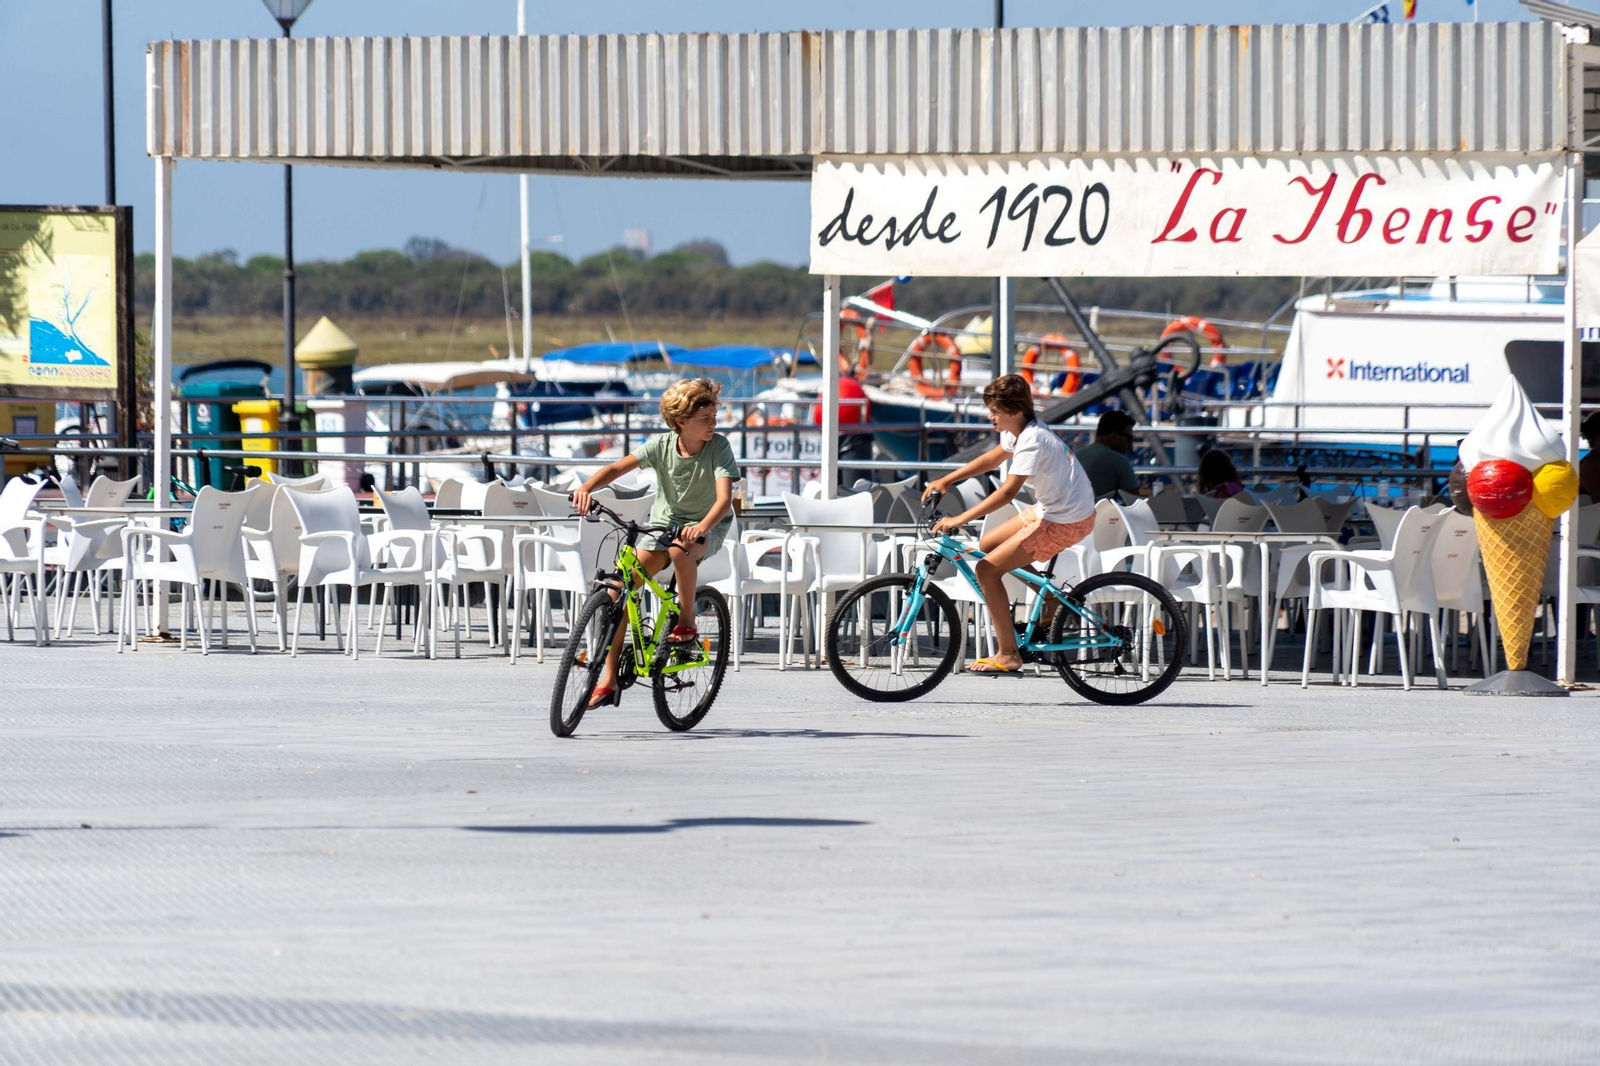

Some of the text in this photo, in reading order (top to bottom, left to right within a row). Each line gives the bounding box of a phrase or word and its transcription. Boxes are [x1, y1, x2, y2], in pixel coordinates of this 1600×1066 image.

[819, 186, 961, 251] desde
[979, 182, 1110, 252] 1920
[1151, 161, 1248, 244] "La
[1350, 361, 1470, 384] International
[753, 436, 823, 454] Prohibi
